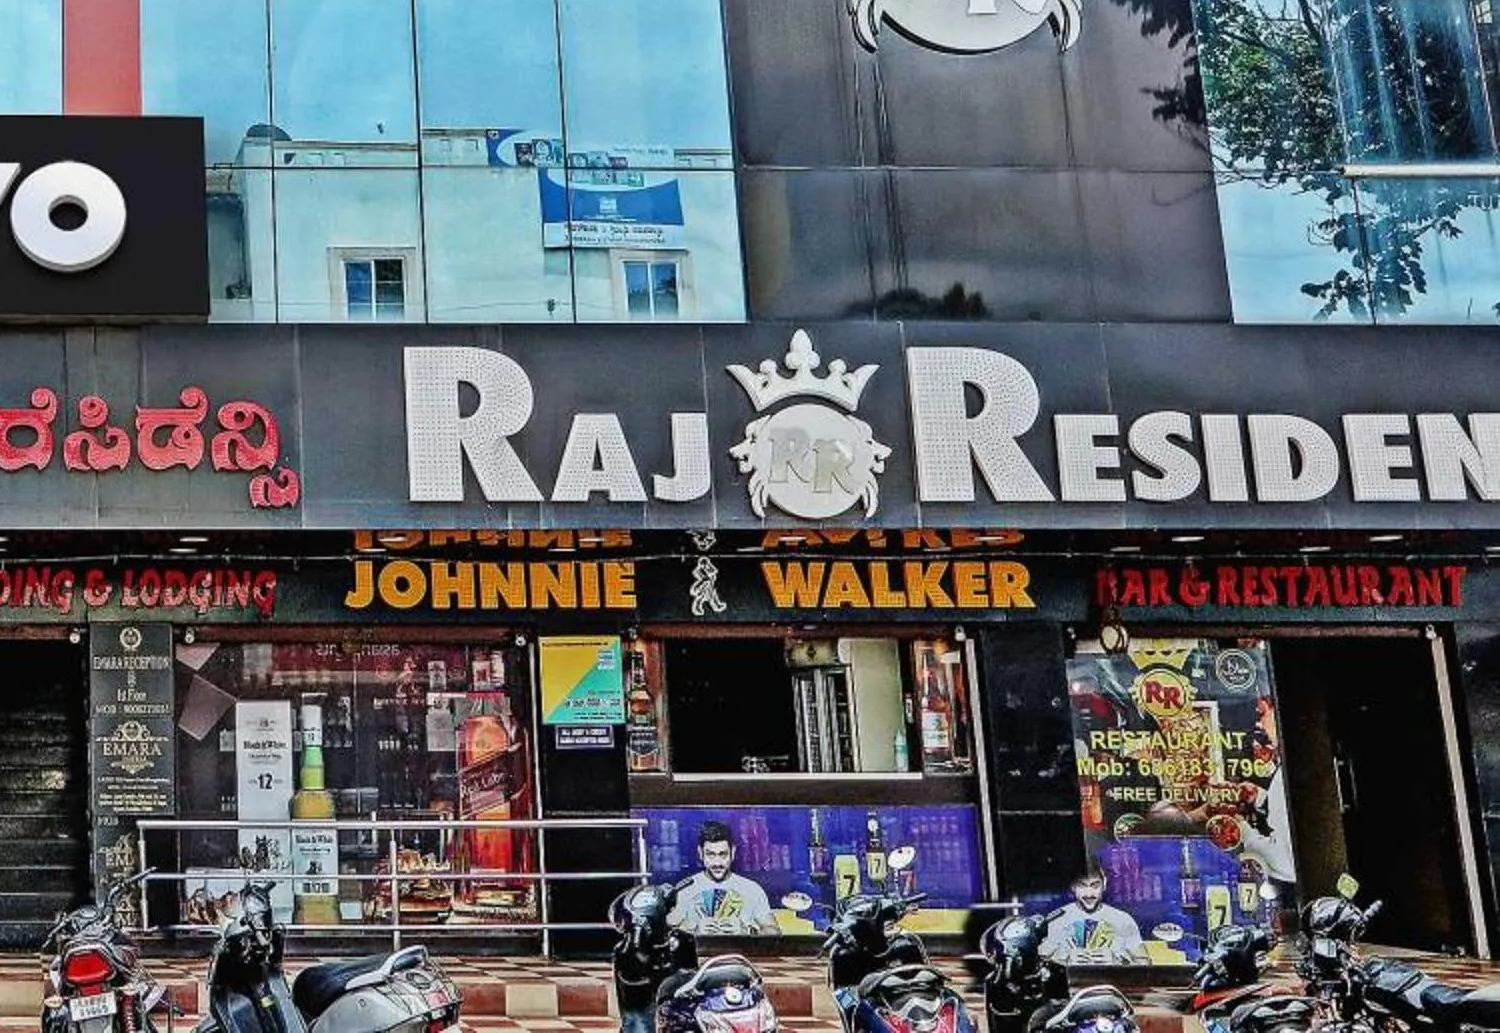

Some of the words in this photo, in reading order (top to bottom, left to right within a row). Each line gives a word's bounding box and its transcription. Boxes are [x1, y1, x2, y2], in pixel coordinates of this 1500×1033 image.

[402, 344, 710, 502] RAJ
[768, 427, 856, 496] RR
[905, 345, 1500, 503] RESIDEN
[83, 569, 112, 607] &
[120, 569, 278, 618] LODGING
[344, 560, 638, 610] JOHNNIE
[761, 561, 1037, 609] WALKER
[1217, 565, 1468, 609] RESTAURANT
[1144, 680, 1183, 711] RR
[103, 742, 162, 756] EMARA
[1089, 730, 1248, 750] RESTAURANT
[257, 772, 273, 790] 12
[1113, 786, 1159, 801] FREE
[1160, 787, 1243, 802] DELIVERY
